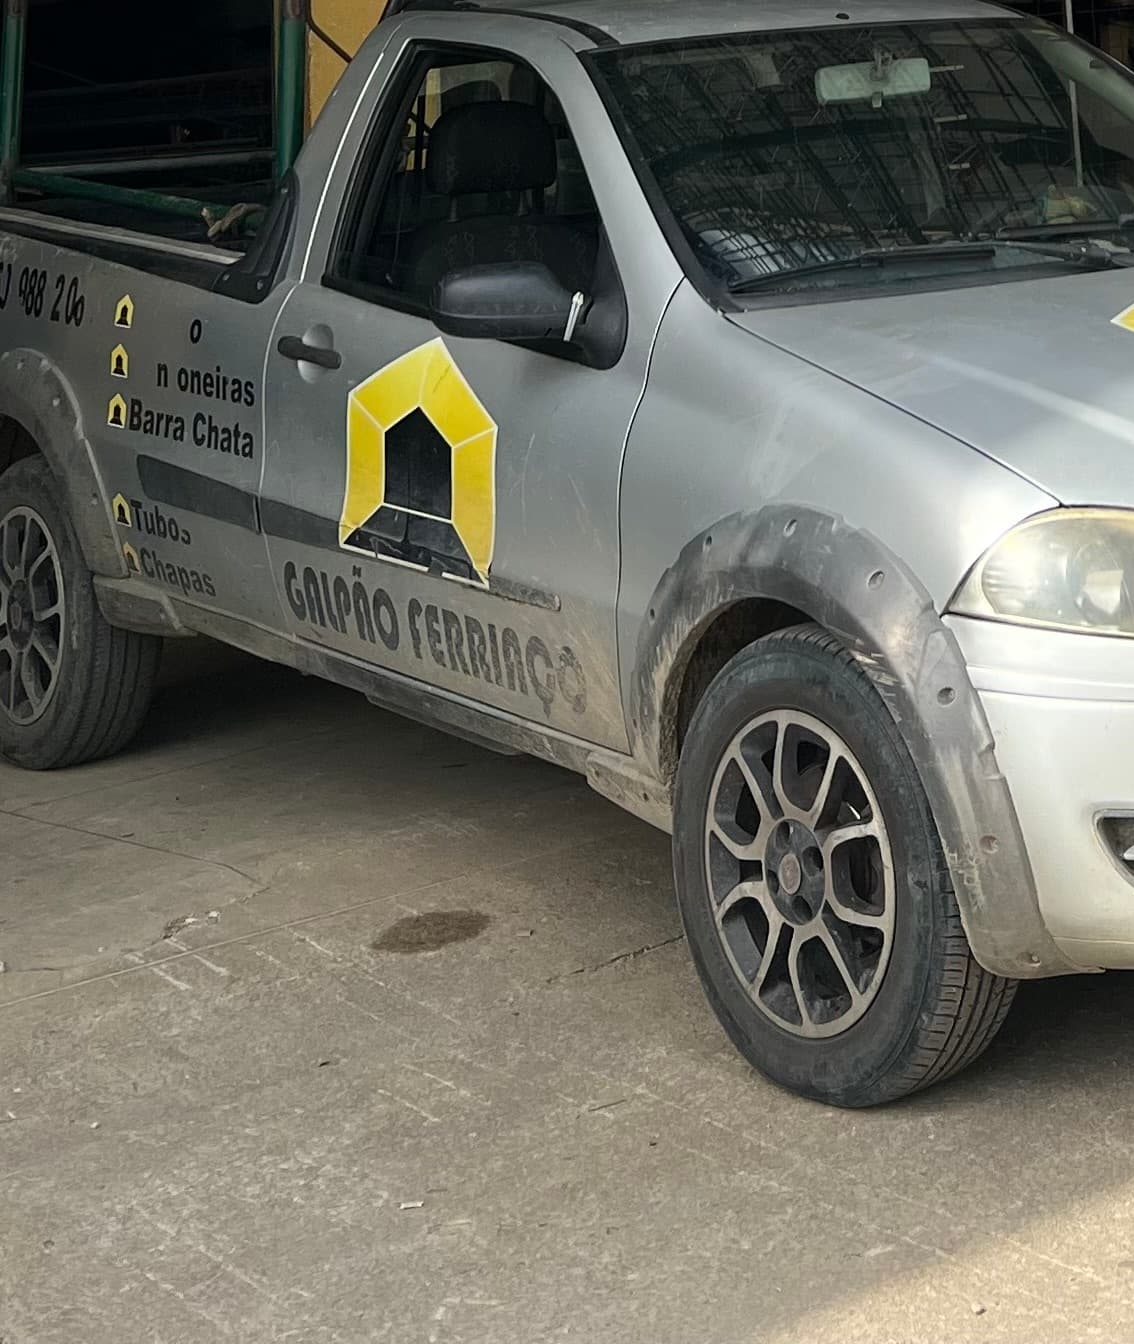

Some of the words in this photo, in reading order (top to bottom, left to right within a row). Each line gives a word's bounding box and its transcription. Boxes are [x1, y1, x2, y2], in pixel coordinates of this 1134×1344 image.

[129, 398, 186, 442] Barra
[192, 413, 254, 458] Chata
[140, 547, 217, 597] Chapas
[284, 561, 400, 652] GALPÃO
